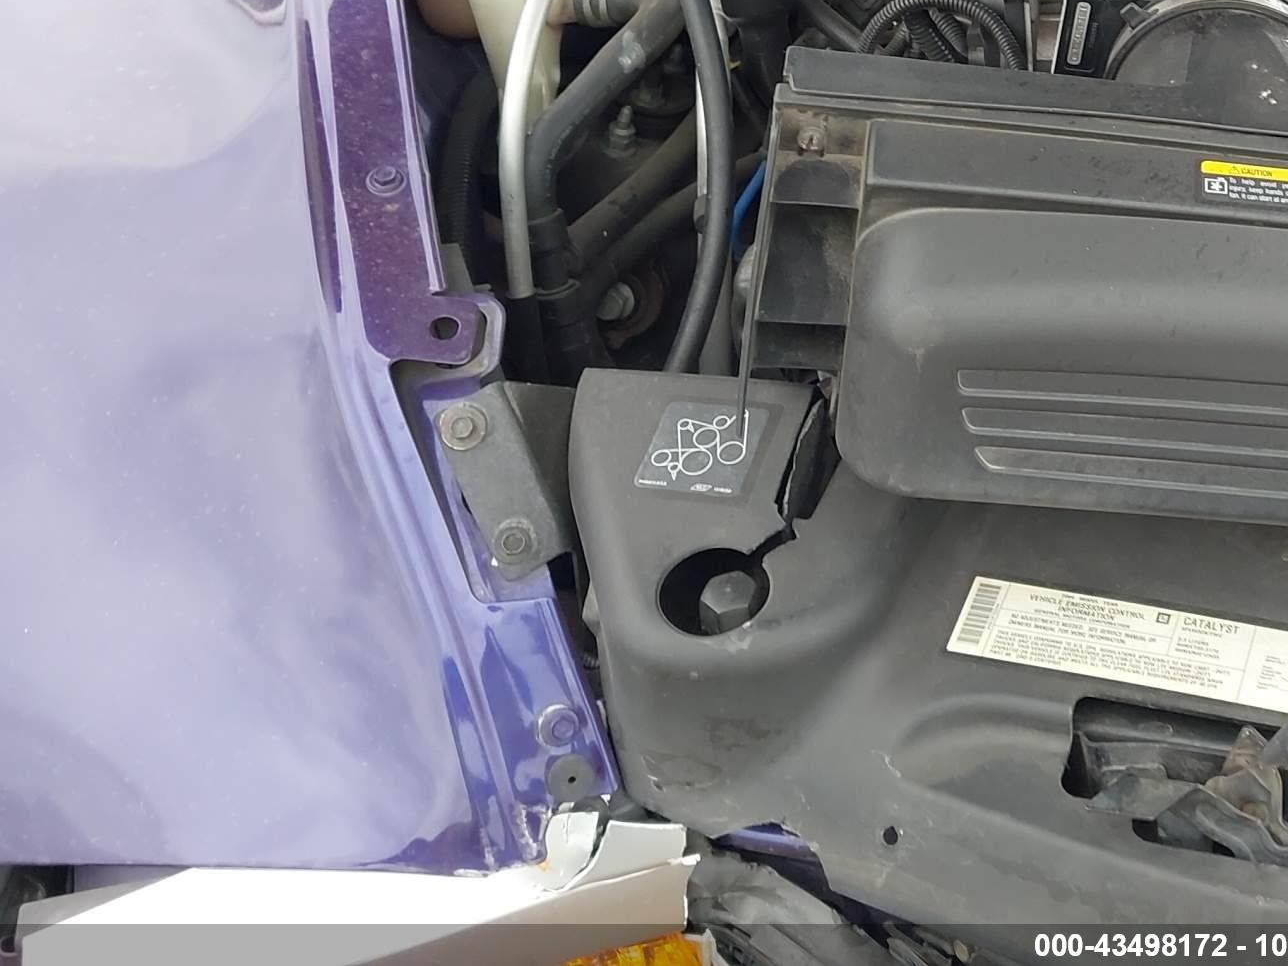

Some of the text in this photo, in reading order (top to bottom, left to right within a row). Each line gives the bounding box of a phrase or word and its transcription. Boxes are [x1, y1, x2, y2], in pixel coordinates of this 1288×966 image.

[1241, 167, 1273, 177] CAUTION
[1030, 594, 1062, 606] VEHICLE
[1065, 600, 1105, 613] EMISSION
[1108, 608, 1145, 620] CONTROL
[1058, 606, 1115, 621] INFORMATION
[1184, 616, 1240, 635] CATALYST
